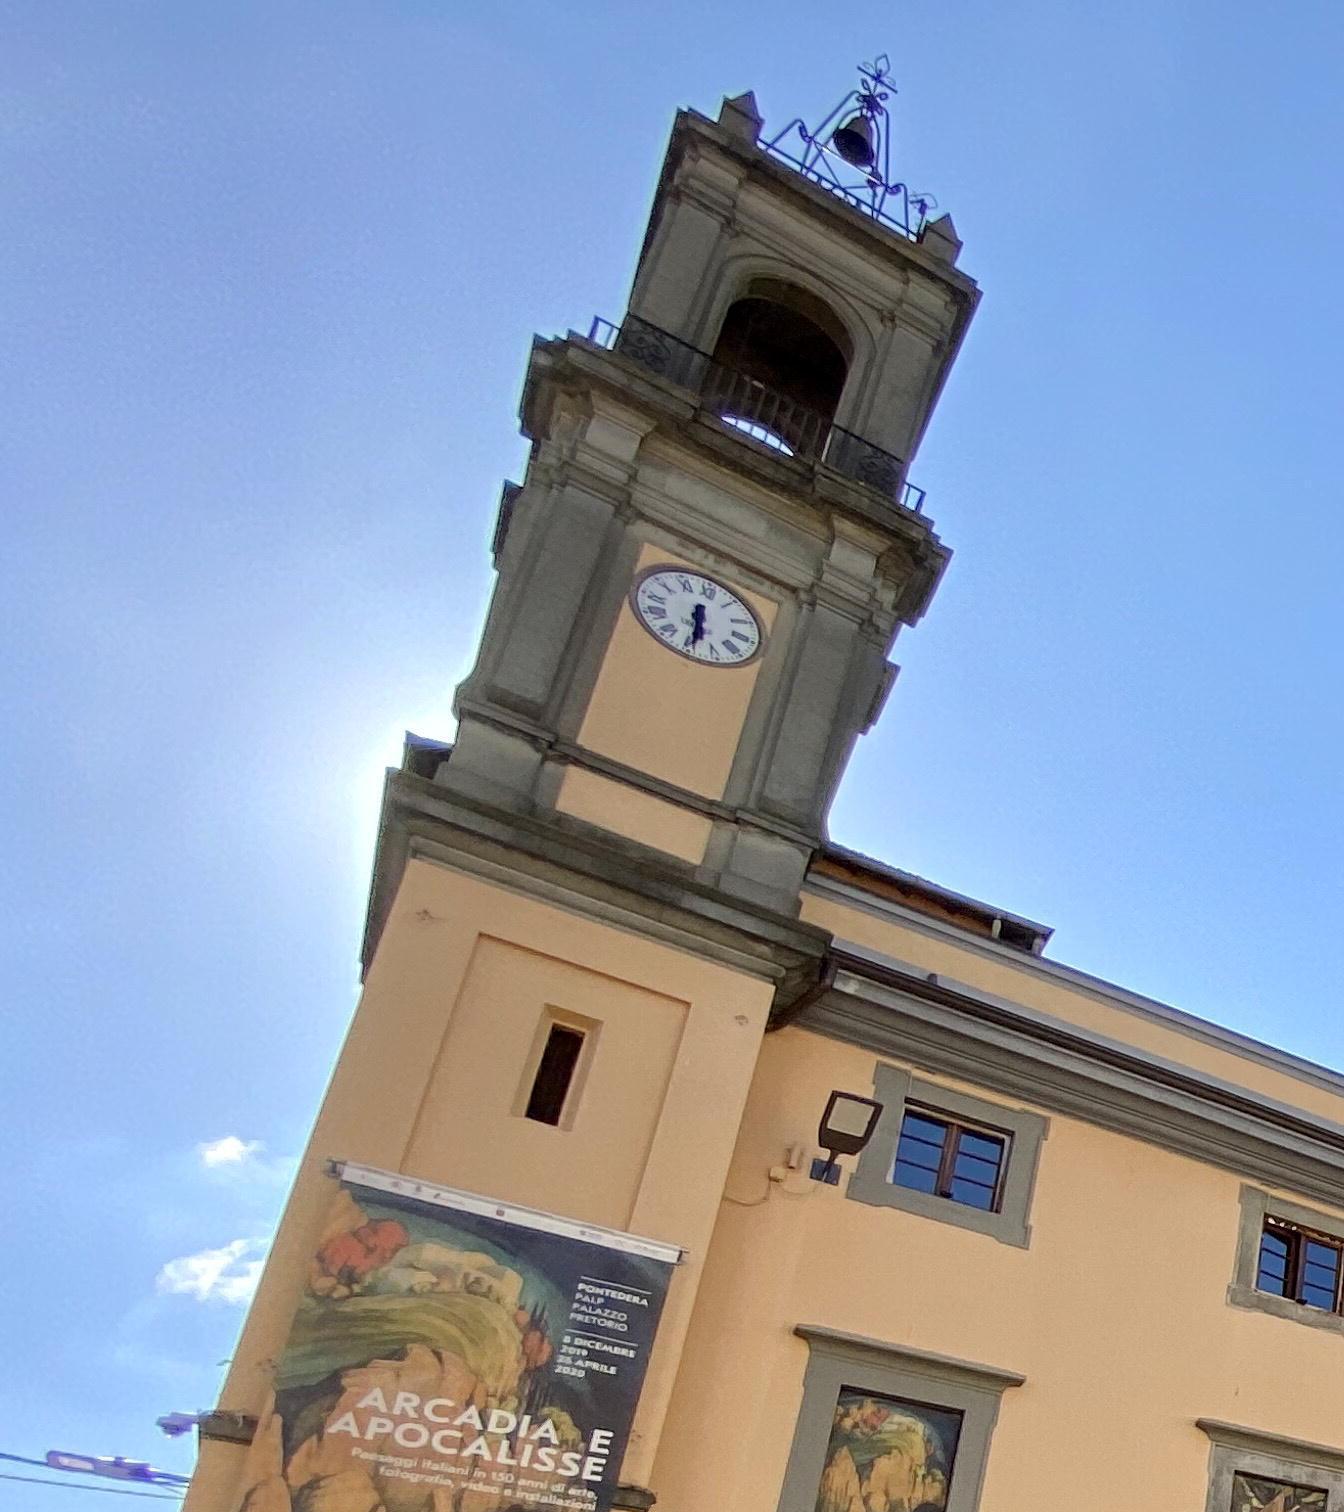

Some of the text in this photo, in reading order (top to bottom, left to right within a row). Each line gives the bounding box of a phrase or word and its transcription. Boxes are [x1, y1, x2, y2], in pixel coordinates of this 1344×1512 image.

[575, 1292, 605, 1305] PALP
[577, 1282, 649, 1308] PONTEDERA
[569, 1312, 628, 1332] PRETORIO
[571, 1302, 628, 1322] PALAZZO
[560, 1344, 588, 1357] 2019
[573, 1337, 637, 1359] DICEMBRE
[554, 1364, 586, 1378] 2020
[574, 1359, 617, 1376] APRILE
[356, 1386, 615, 1456] ARCADIA E
[326, 1411, 608, 1483] APOCALISSE
[351, 1446, 599, 1501] Paesaggi italiani in 150 anni di arte,
[460, 1481, 499, 1495] video
[503, 1488, 512, 1497] e
[515, 1490, 597, 1512] installazioni
